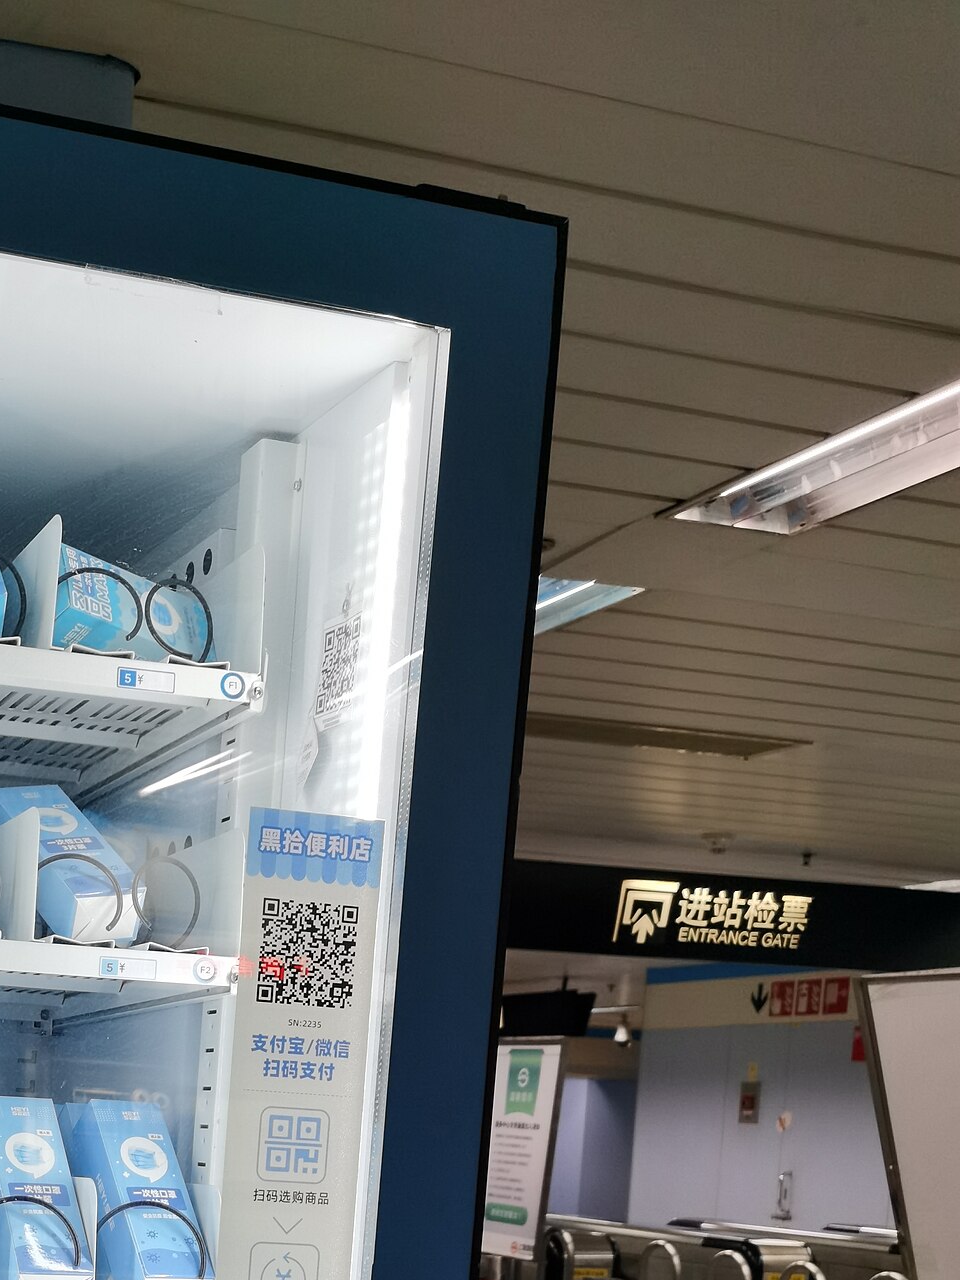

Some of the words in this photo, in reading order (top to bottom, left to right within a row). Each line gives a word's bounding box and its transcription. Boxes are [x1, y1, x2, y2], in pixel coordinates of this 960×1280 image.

[124, 673, 132, 684] 5
[260, 827, 372, 862] 黑拾便利店
[675, 887, 815, 932] 进站检票
[678, 927, 759, 947] ENTRANCE
[762, 931, 801, 950] GATE
[106, 962, 114, 973] 5
[200, 965, 211, 975] F2
[288, 1018, 322, 1029] SN:2235
[251, 1033, 351, 1059] 支付宝/微信
[263, 1058, 335, 1082] 扫码支付
[15, 1185, 61, 1194] 一次性口罩
[133, 1188, 177, 1199] 一次性口罩
[253, 1188, 329, 1205] 扫码选购商品
